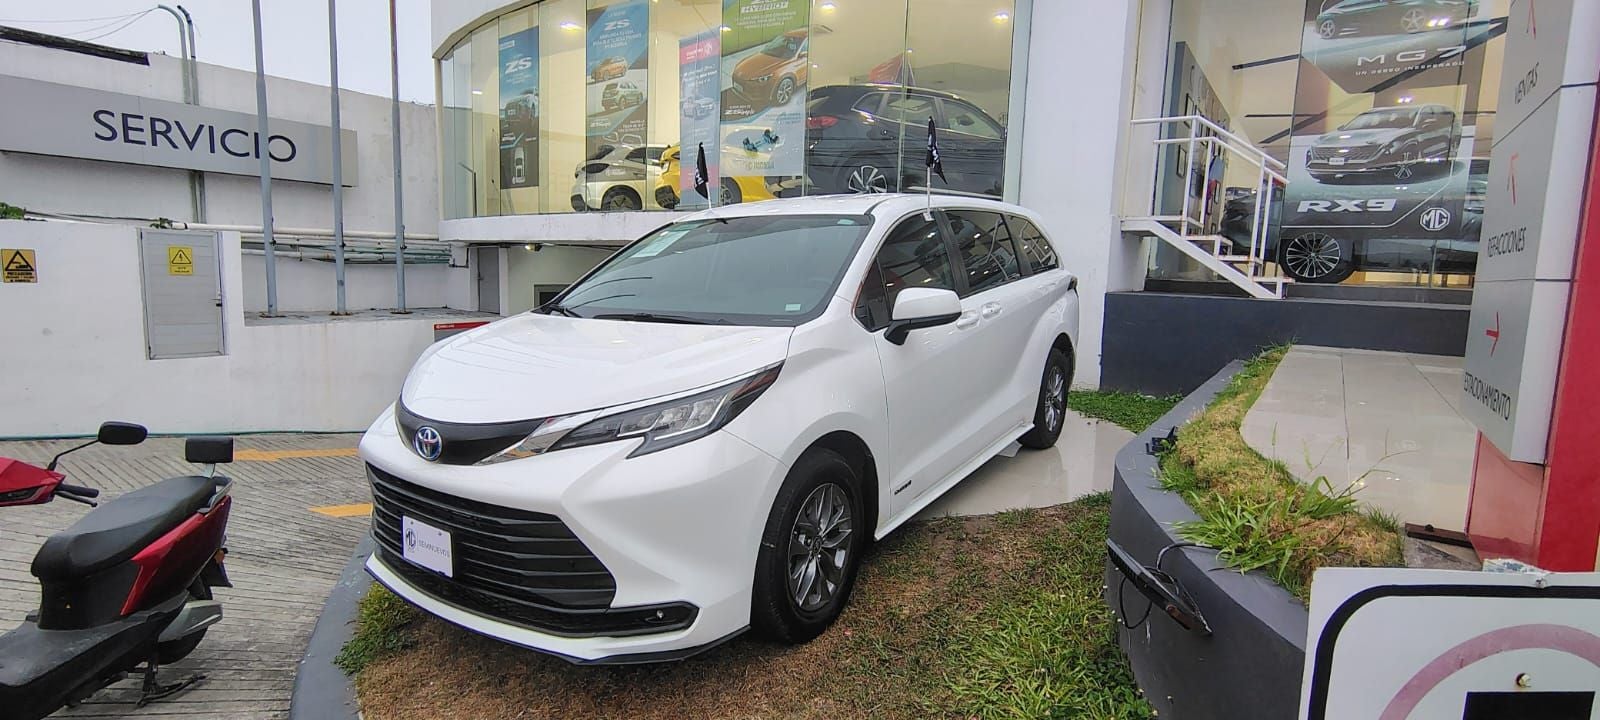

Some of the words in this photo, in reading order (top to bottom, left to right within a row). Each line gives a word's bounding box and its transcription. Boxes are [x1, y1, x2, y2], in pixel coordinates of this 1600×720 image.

[604, 18, 630, 31] ZS
[504, 56, 532, 74] ZS
[1515, 61, 1539, 104] VENTAS
[93, 109, 297, 163] SERVICIO
[1297, 199, 1397, 213] RX9
[1421, 208, 1450, 230] MG
[1487, 226, 1527, 258] REFACCIONES
[1463, 371, 1511, 421] ESTACIONAMIENTO
